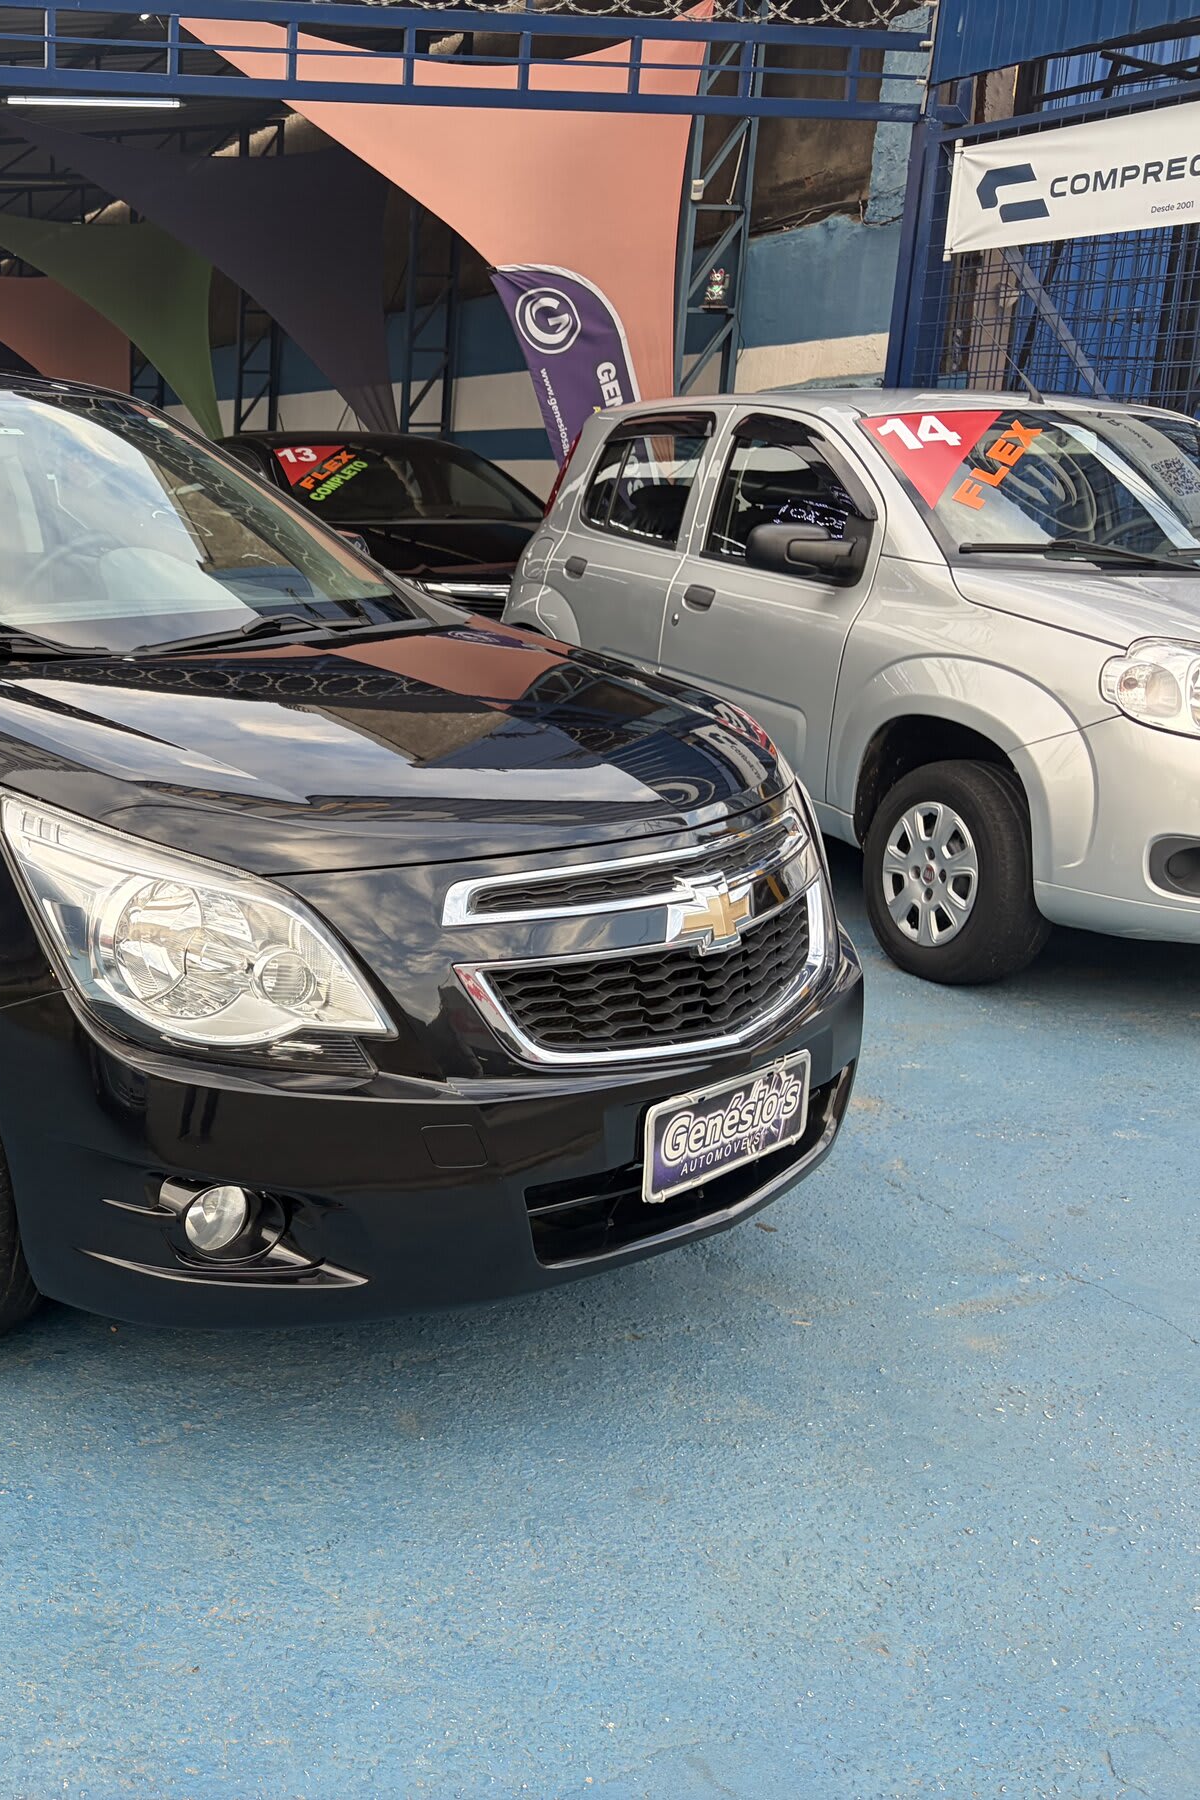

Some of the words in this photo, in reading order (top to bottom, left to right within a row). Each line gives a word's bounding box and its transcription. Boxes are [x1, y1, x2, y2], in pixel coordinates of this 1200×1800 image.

[1151, 203, 1175, 214] Desde
[1176, 200, 1195, 210] 2001
[877, 415, 962, 450] 14
[278, 447, 318, 463] 13
[300, 451, 356, 490] FLEX
[951, 419, 1043, 510] FLEX
[309, 460, 368, 501] COMPLETO
